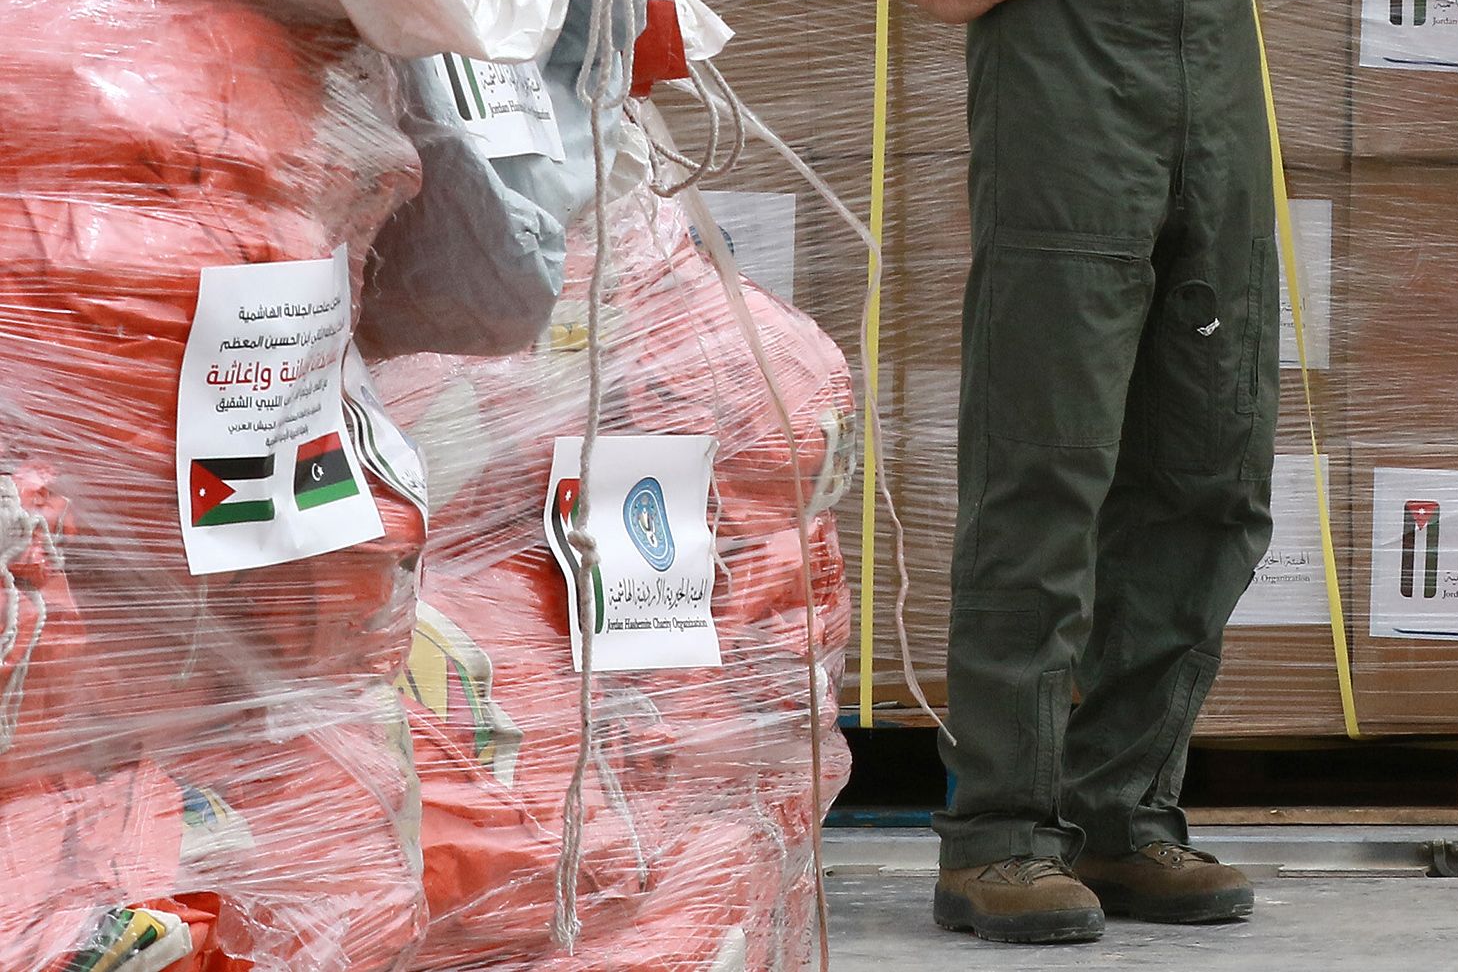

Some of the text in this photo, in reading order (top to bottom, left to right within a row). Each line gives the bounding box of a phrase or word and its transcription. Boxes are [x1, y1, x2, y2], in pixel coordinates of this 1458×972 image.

[1432, 16, 1458, 26] Jordan
[239, 304, 282, 323] الهاشمية
[283, 303, 312, 319] الجلالة
[219, 335, 264, 353] المعظم
[264, 332, 300, 349] الحسين
[206, 360, 272, 391] وإغاثية
[215, 395, 283, 412] الليبي الشقيق
[606, 616, 708, 634] Jordan Hashemite Charity Organization
